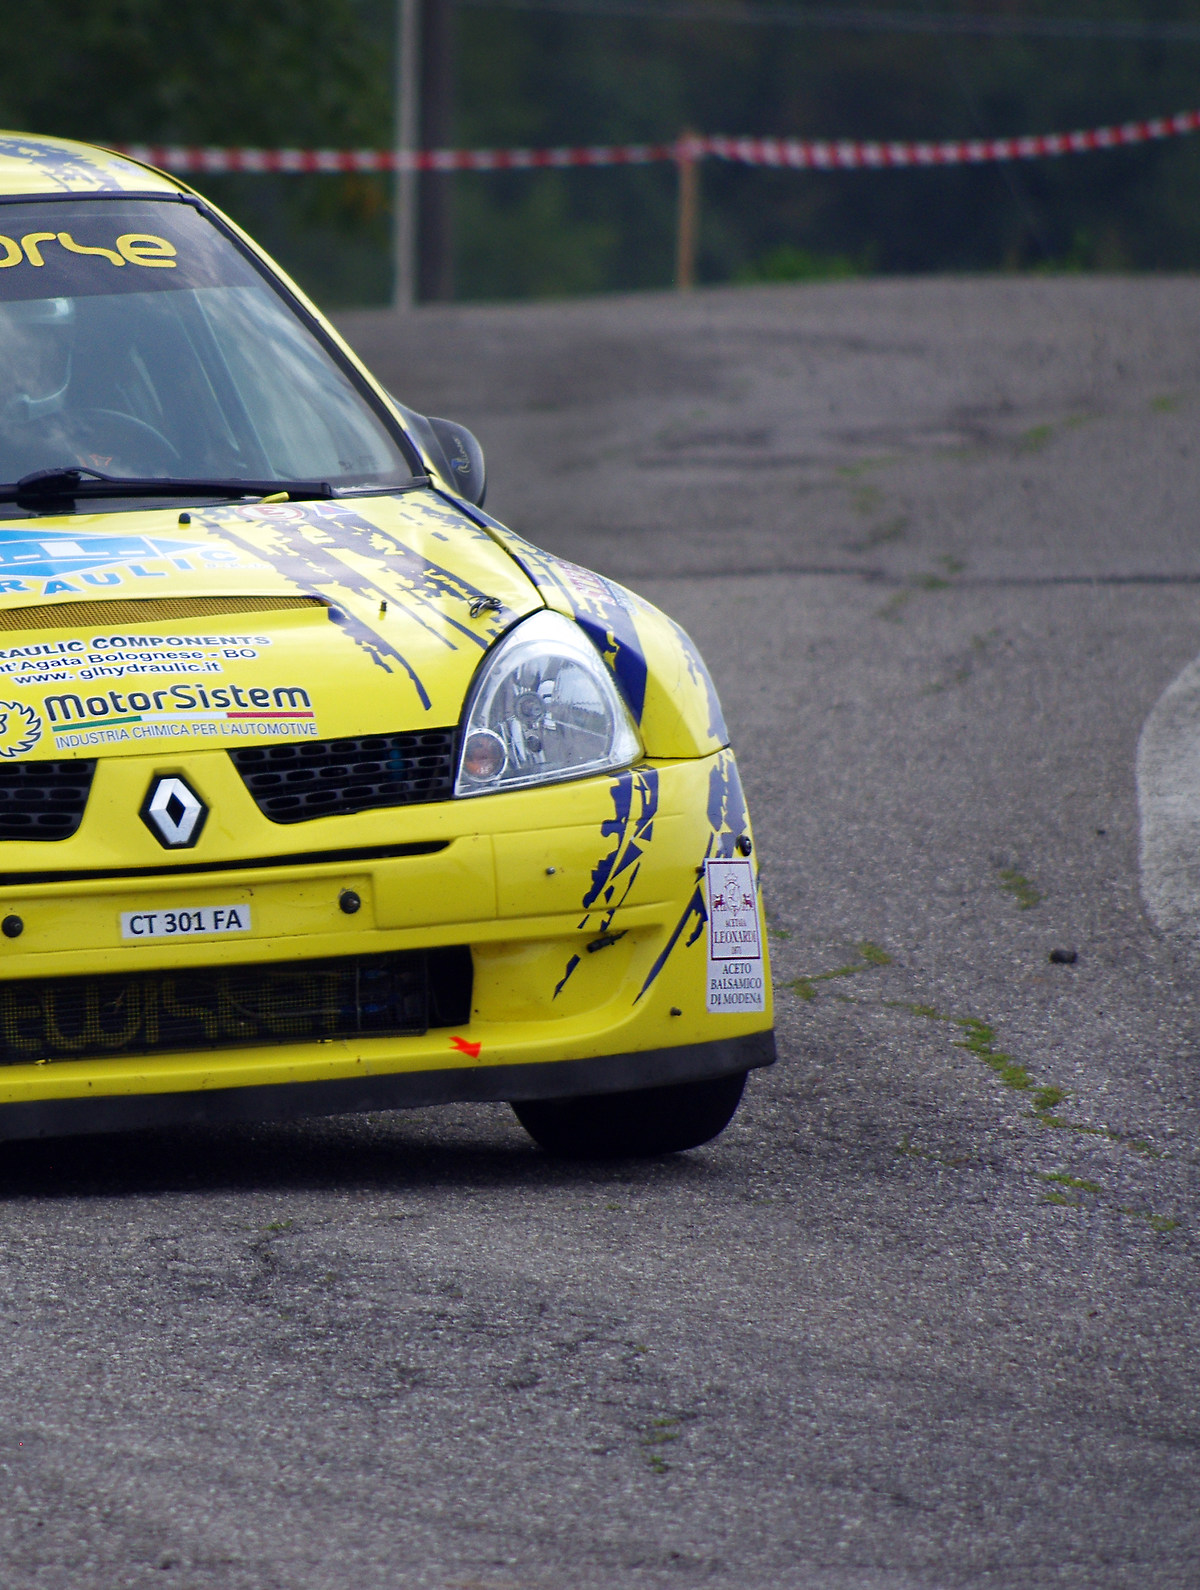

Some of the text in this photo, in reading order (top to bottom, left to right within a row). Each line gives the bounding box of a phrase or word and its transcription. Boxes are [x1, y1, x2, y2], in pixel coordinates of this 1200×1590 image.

[92, 635, 272, 652] COMPONENTS
[89, 649, 204, 664] Bolognese
[223, 648, 258, 660] BO
[14, 660, 222, 685] www. glhydraulic.it
[44, 683, 313, 722] MotorSistem
[55, 721, 319, 749] INDUSTRIA CHIMICA PER L'AUTOMOTIVE
[129, 909, 243, 935] CT 301 FA
[714, 930, 757, 944] LEONARDI
[722, 963, 752, 975] ACETO
[710, 977, 762, 991] BALSAMICO
[710, 992, 762, 1005] DI MODENA
